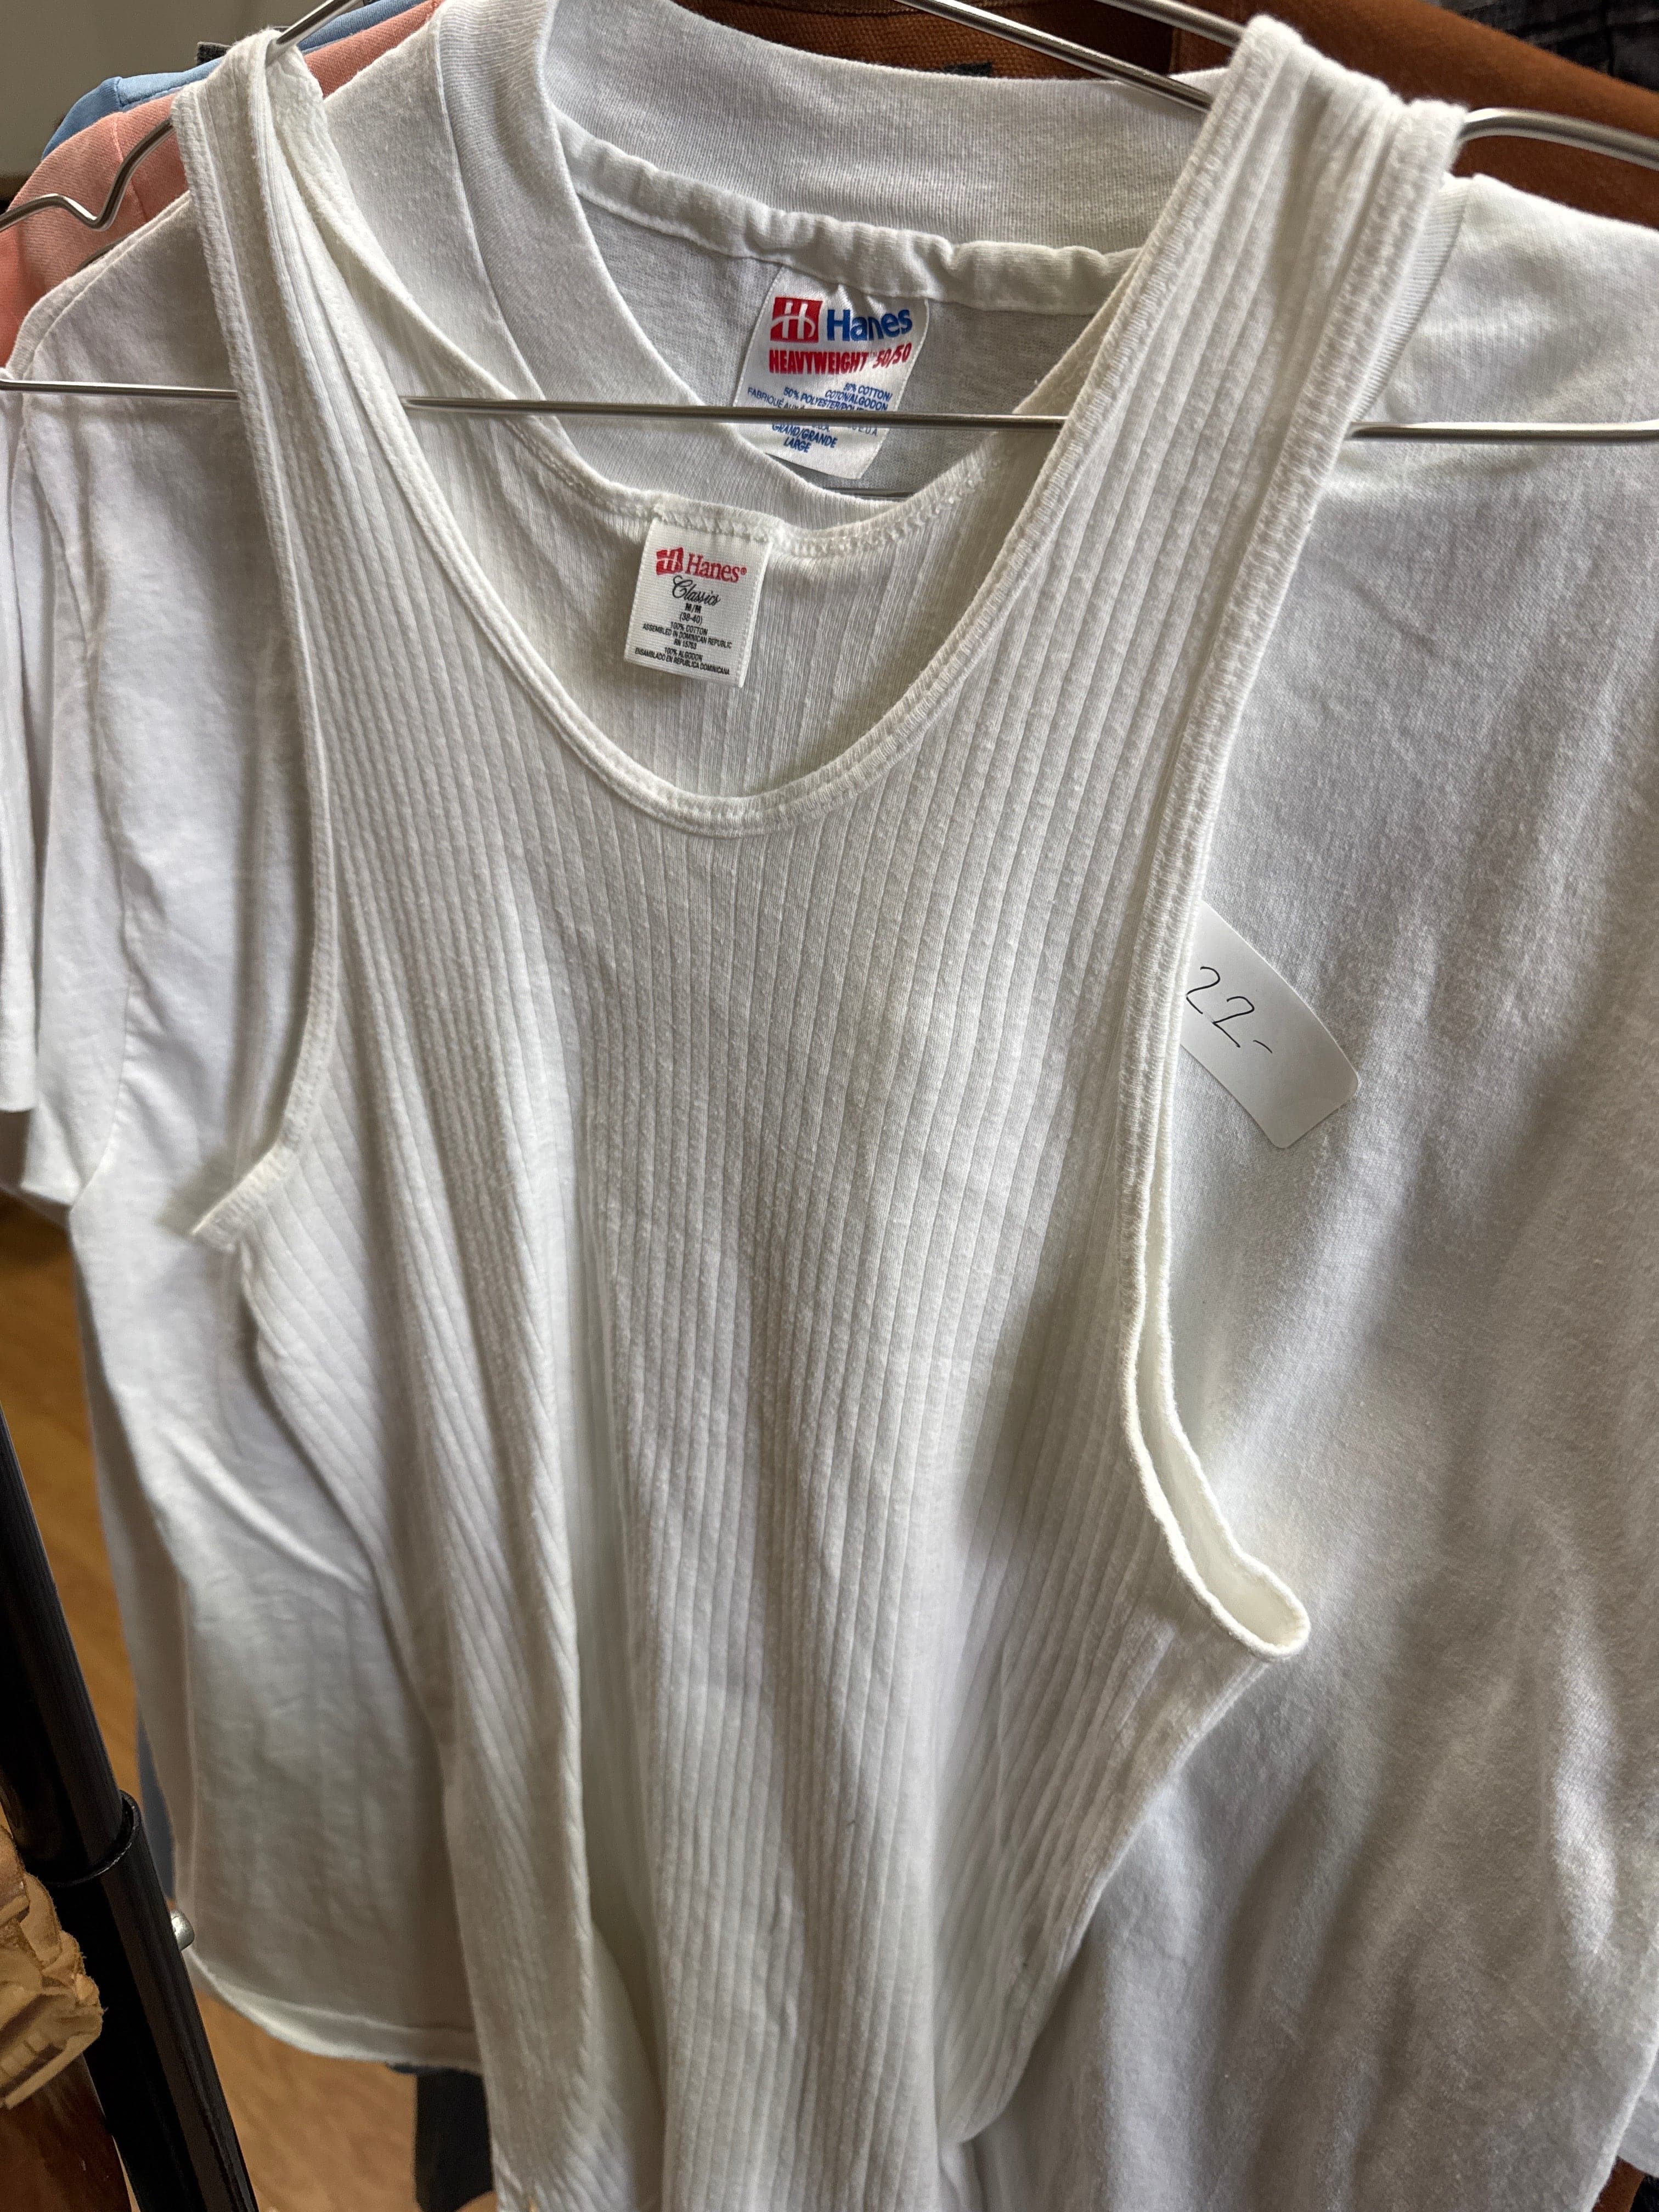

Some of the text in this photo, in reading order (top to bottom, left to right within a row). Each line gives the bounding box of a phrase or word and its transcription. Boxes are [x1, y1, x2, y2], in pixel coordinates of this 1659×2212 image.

[826, 309, 913, 341] Hanes
[872, 342, 912, 369] 50/50
[783, 386, 799, 400] 50%
[783, 437, 812, 453] LARGE
[672, 575, 721, 606] Classics
[684, 603, 702, 614] M/M
[679, 612, 703, 625] (38-40)
[642, 623, 672, 636] ASSEMBLED
[679, 631, 708, 645] DOMINICAN
[708, 637, 733, 649] REPUBLIC
[670, 621, 709, 636] 100% COTTON
[635, 647, 666, 662] ENSAMBLADO
[665, 655, 673, 663] EN
[664, 647, 703, 662] 100% ALGODON
